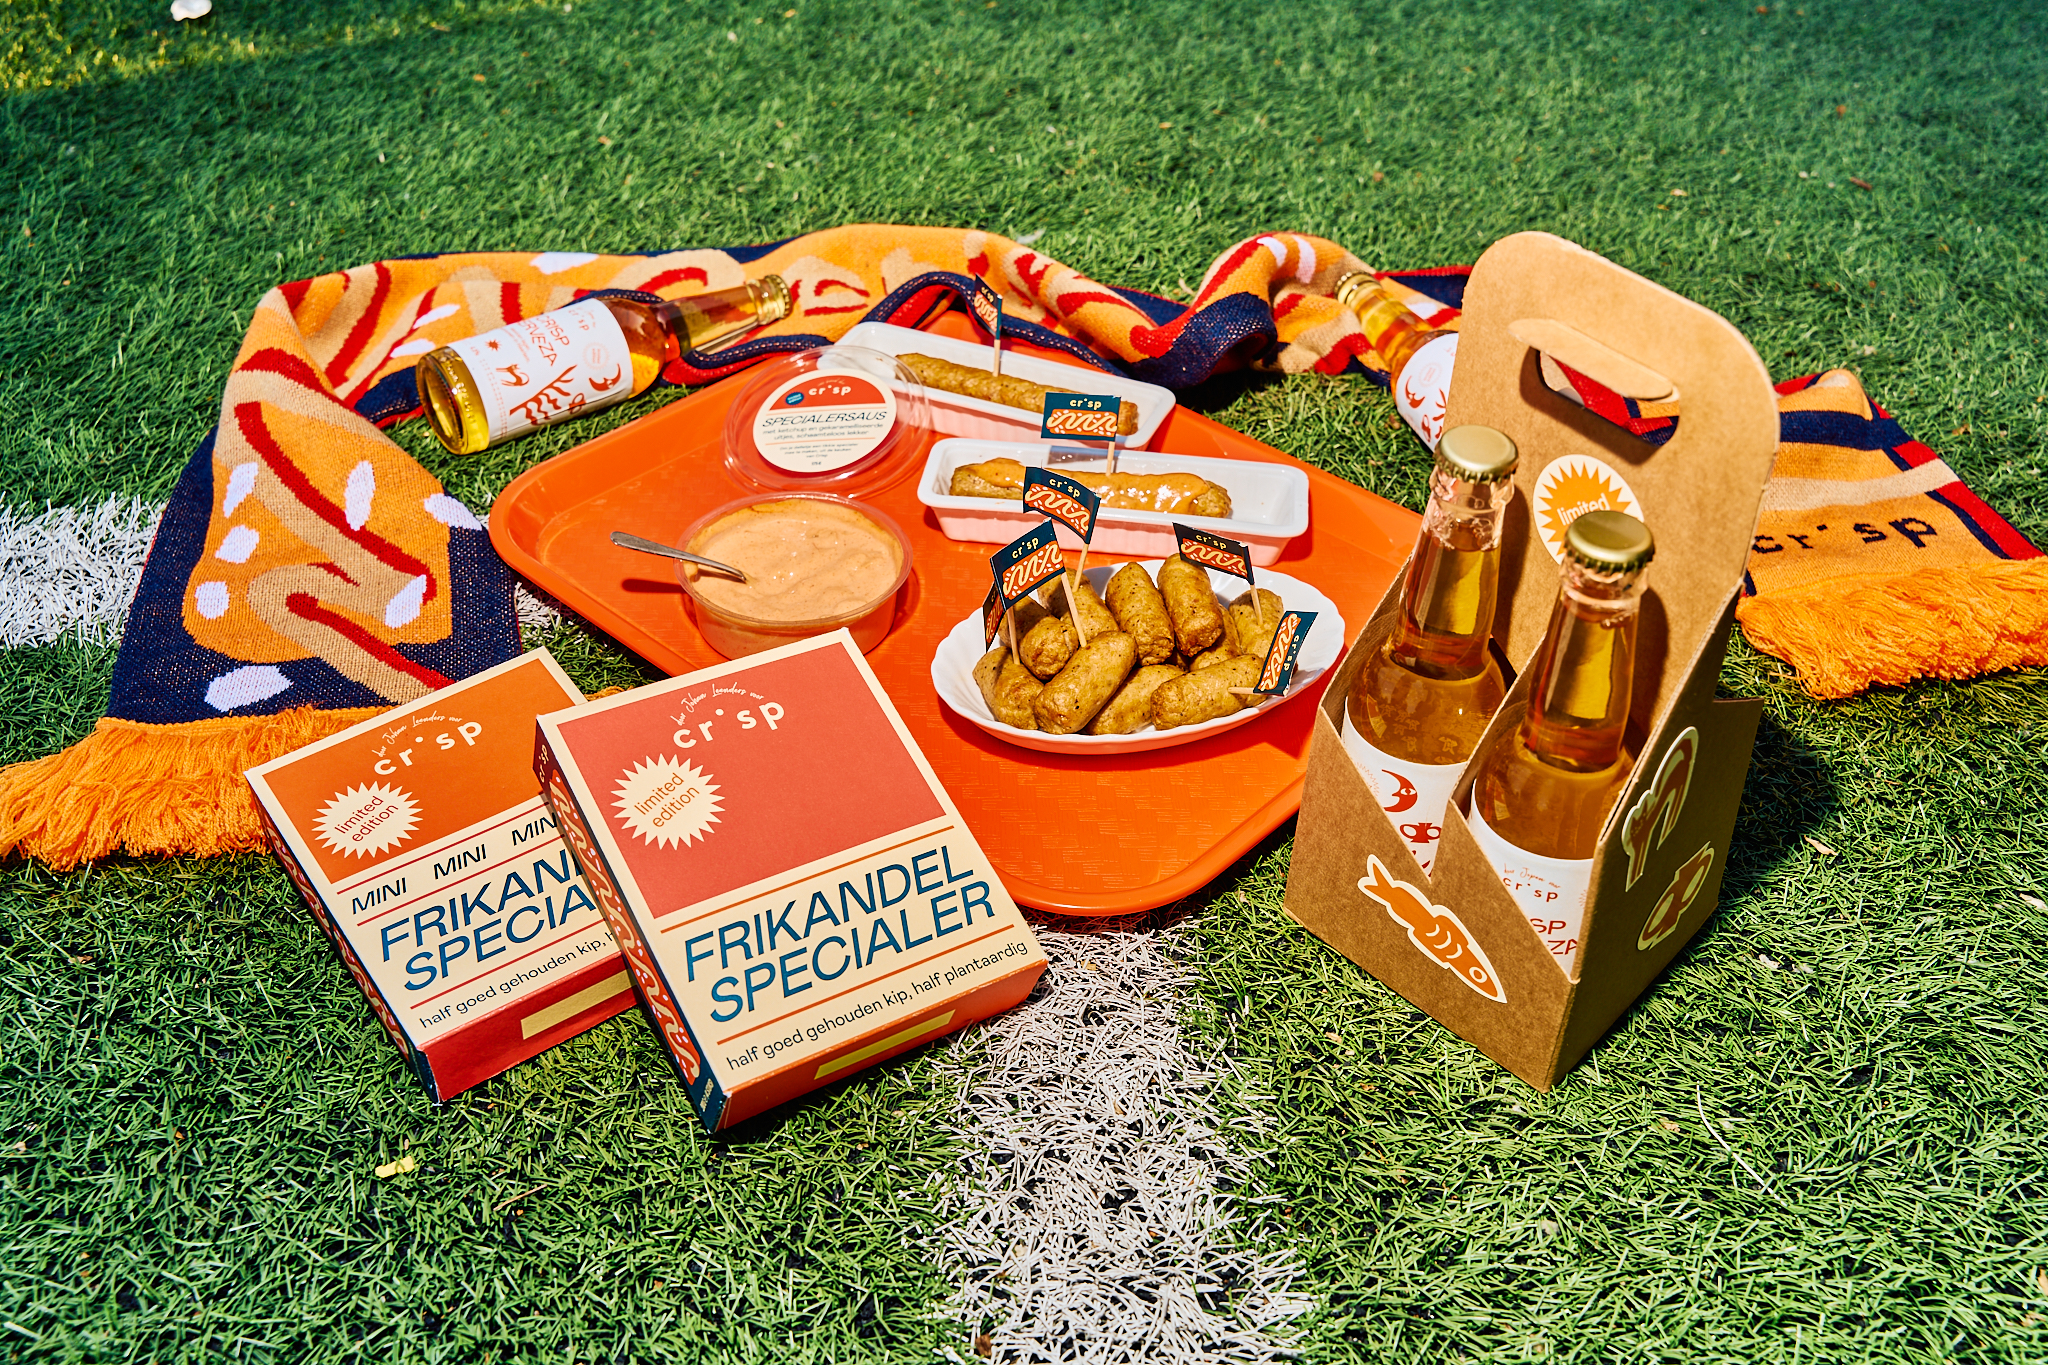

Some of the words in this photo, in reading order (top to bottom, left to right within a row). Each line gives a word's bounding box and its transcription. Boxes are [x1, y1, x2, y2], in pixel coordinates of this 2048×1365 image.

[762, 411, 888, 427] SPECIALERSAUS
[1557, 492, 1611, 526] limited
[334, 795, 384, 835] limited
[352, 804, 400, 842] edition
[633, 772, 685, 816] limited
[652, 786, 700, 828] edition
[352, 877, 408, 915] MINI
[433, 843, 488, 880] MINI
[511, 812, 558, 846] MIN
[380, 848, 583, 963] FRIKAN
[403, 883, 597, 991] SPECIA
[684, 845, 974, 983] FRIKANDEL
[709, 880, 996, 1023] SPECIALER
[419, 1005, 454, 1029] half
[455, 985, 497, 1015] goed
[499, 950, 577, 994] gehouden
[575, 937, 607, 956] kip,
[725, 1046, 760, 1071] half
[762, 1029, 805, 1059] goed
[806, 1002, 884, 1042] gehouden
[884, 987, 914, 1009] kip,
[911, 972, 943, 997] half
[943, 941, 1028, 987] plantaardig
